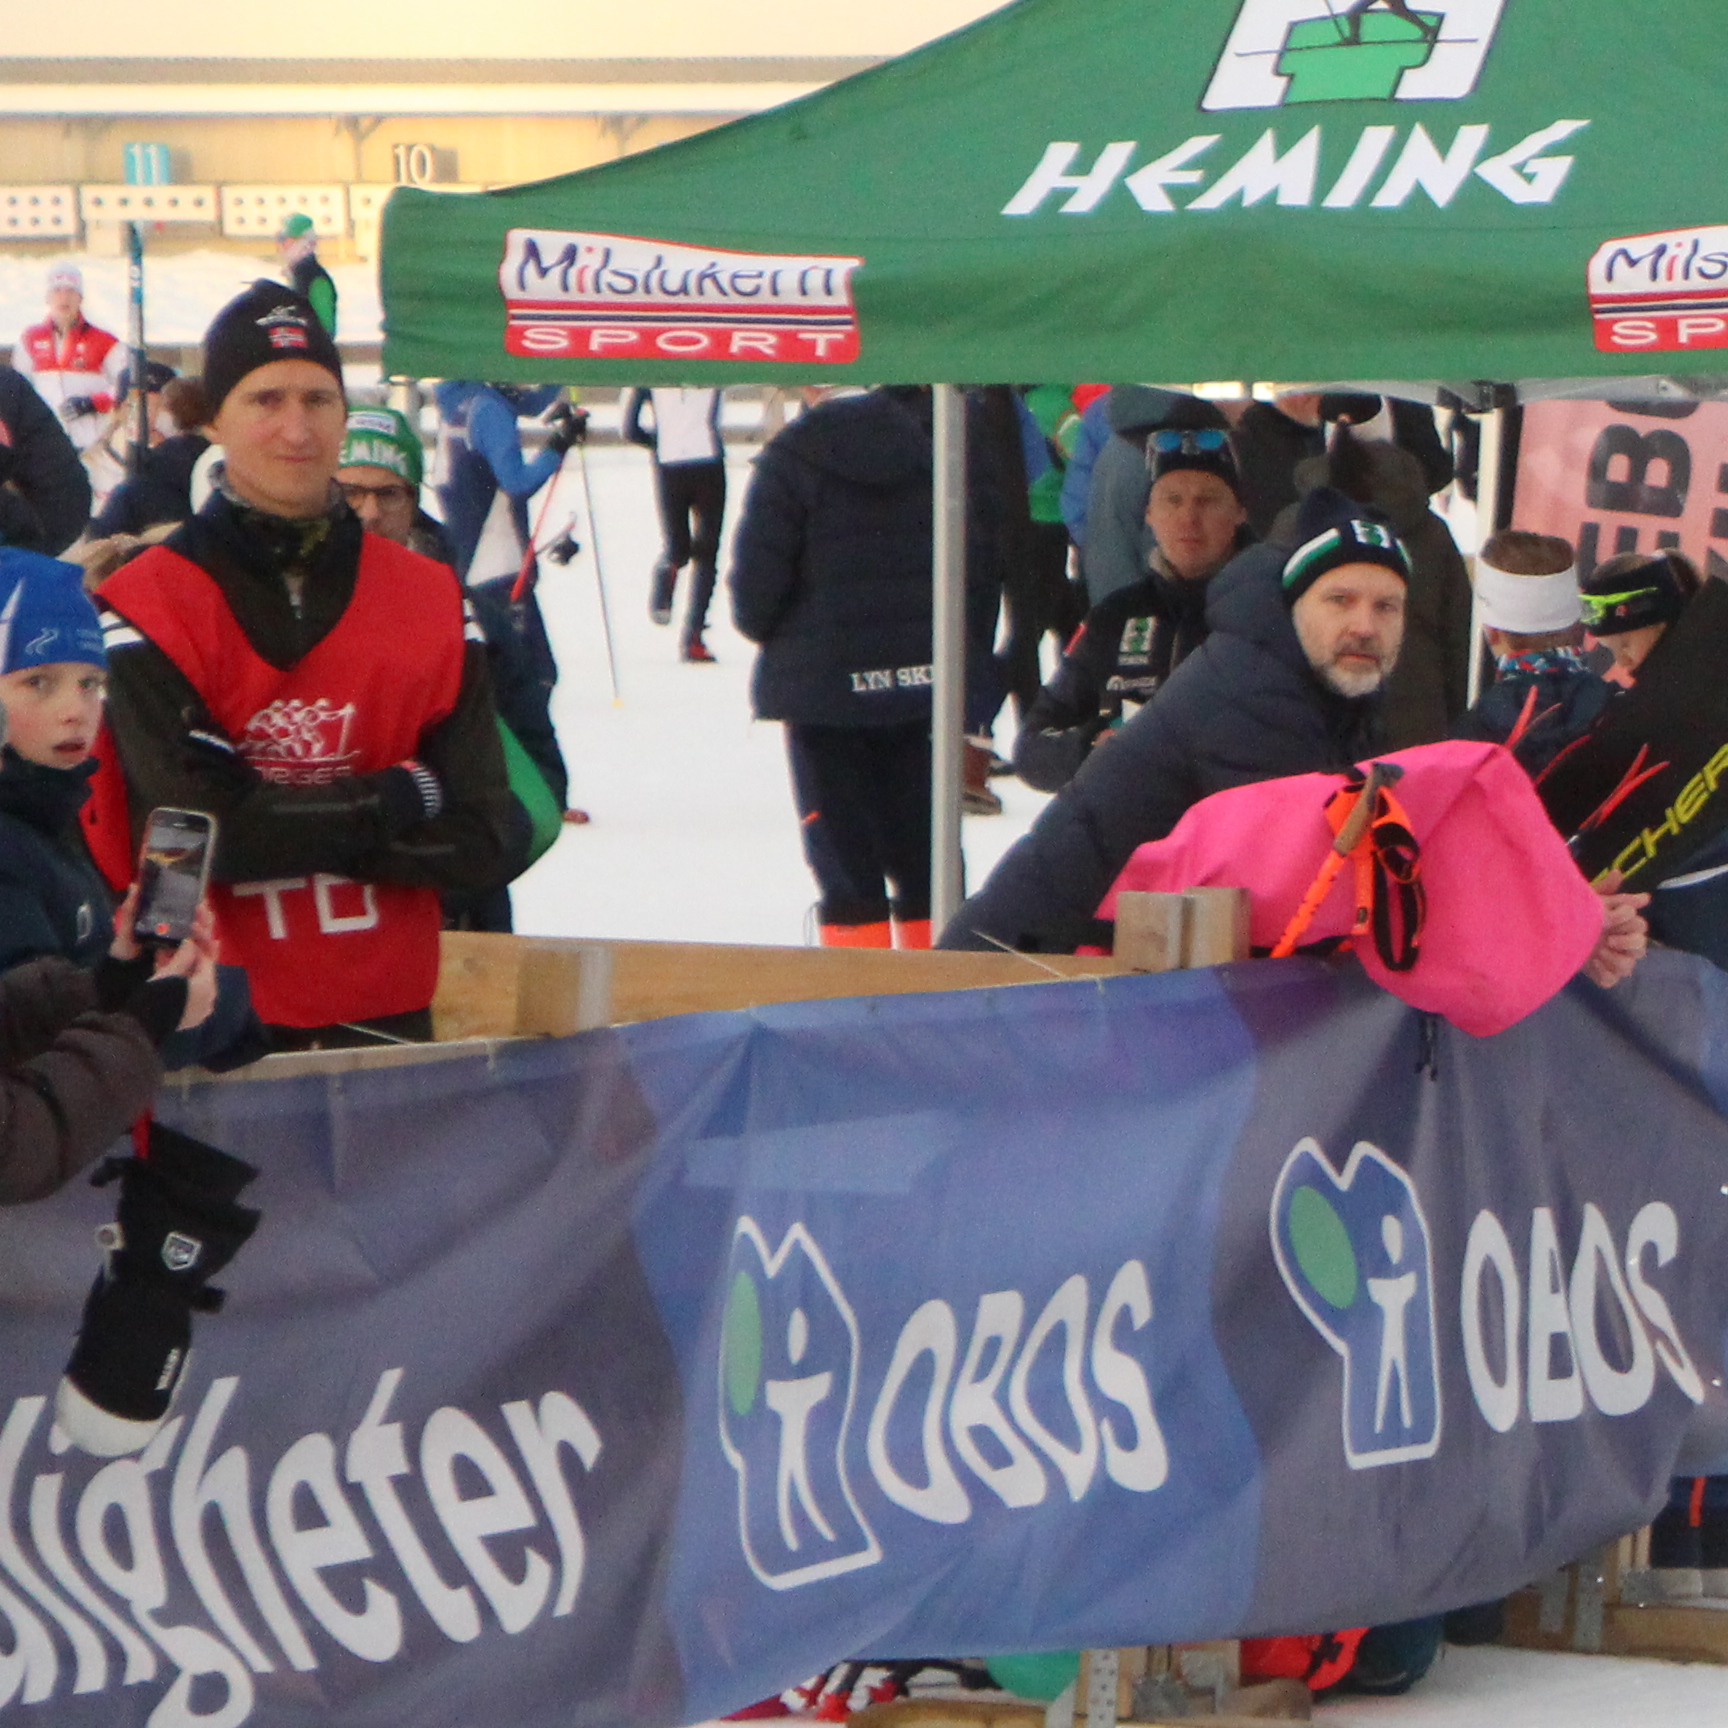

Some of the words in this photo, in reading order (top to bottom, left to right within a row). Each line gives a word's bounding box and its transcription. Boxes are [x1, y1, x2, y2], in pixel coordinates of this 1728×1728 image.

[393, 143, 432, 184] 10
[1001, 119, 1591, 216] HEMING
[517, 236, 834, 297] Milslukern
[521, 328, 846, 358] SPORT
[849, 668, 895, 693] LYN
[896, 664, 934, 688] SK
[231, 872, 380, 941] TD
[1461, 1201, 1704, 1433] OBOS
[866, 1259, 1168, 1525] OBOS
